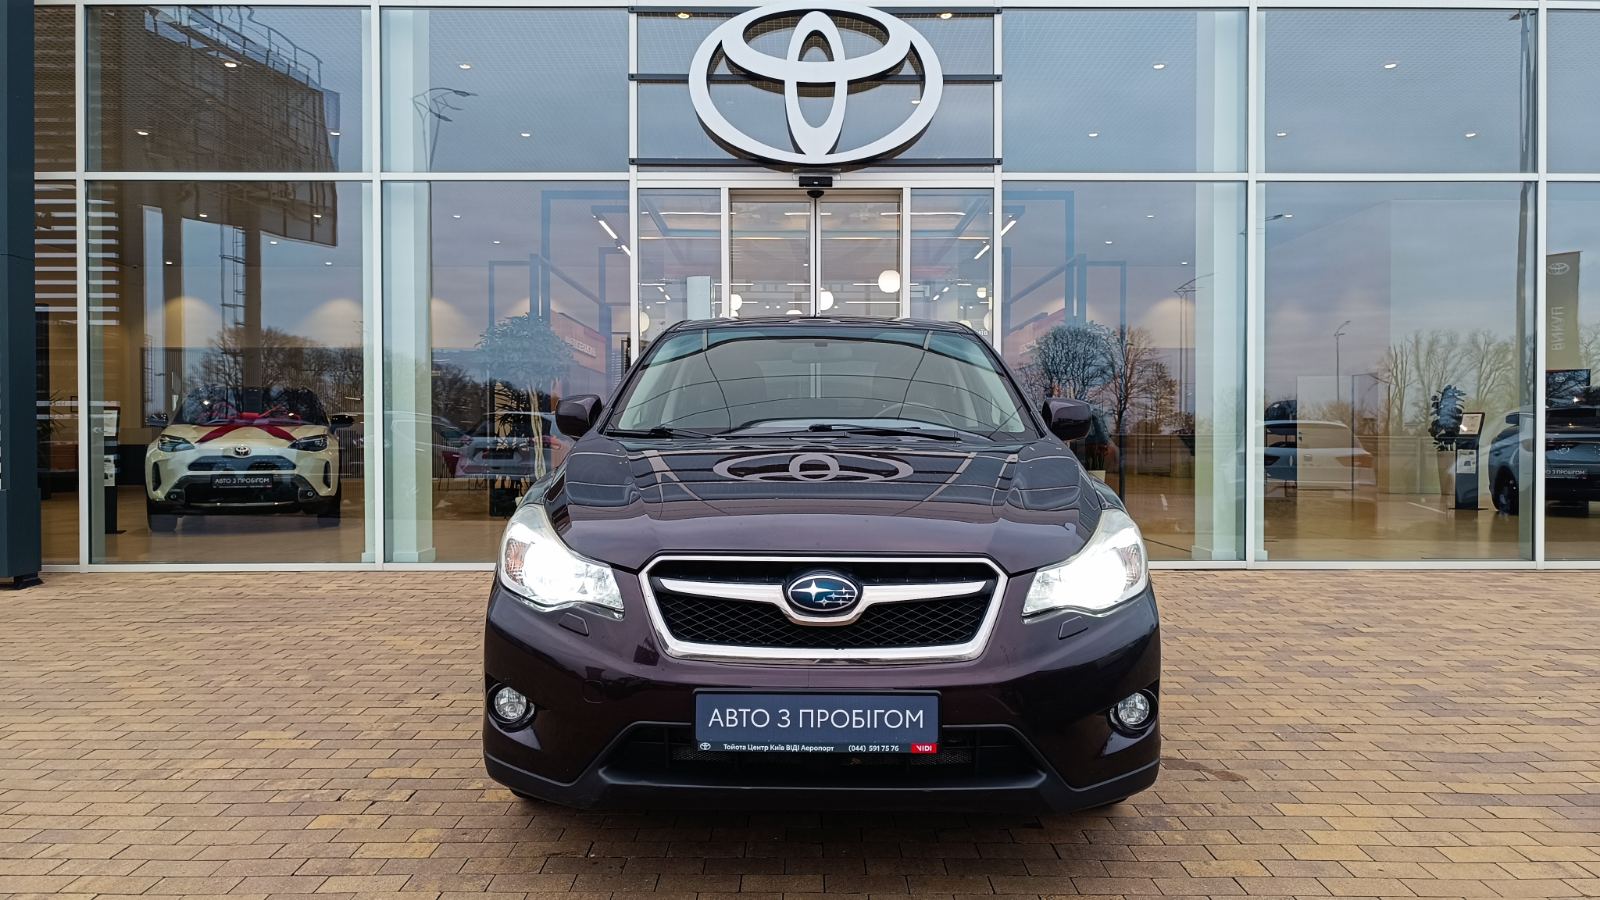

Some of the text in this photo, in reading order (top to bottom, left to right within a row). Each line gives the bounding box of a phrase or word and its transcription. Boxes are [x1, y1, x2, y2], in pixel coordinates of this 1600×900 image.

[709, 708, 924, 729] АВТО З ПРОБІГОМ
[723, 743, 747, 751] Тойота
[748, 743, 769, 752] Центр
[800, 744, 835, 752] Аеропорт
[848, 744, 867, 753] (044)
[868, 744, 880, 752] 591
[881, 744, 890, 752] 75
[890, 744, 900, 752] 76
